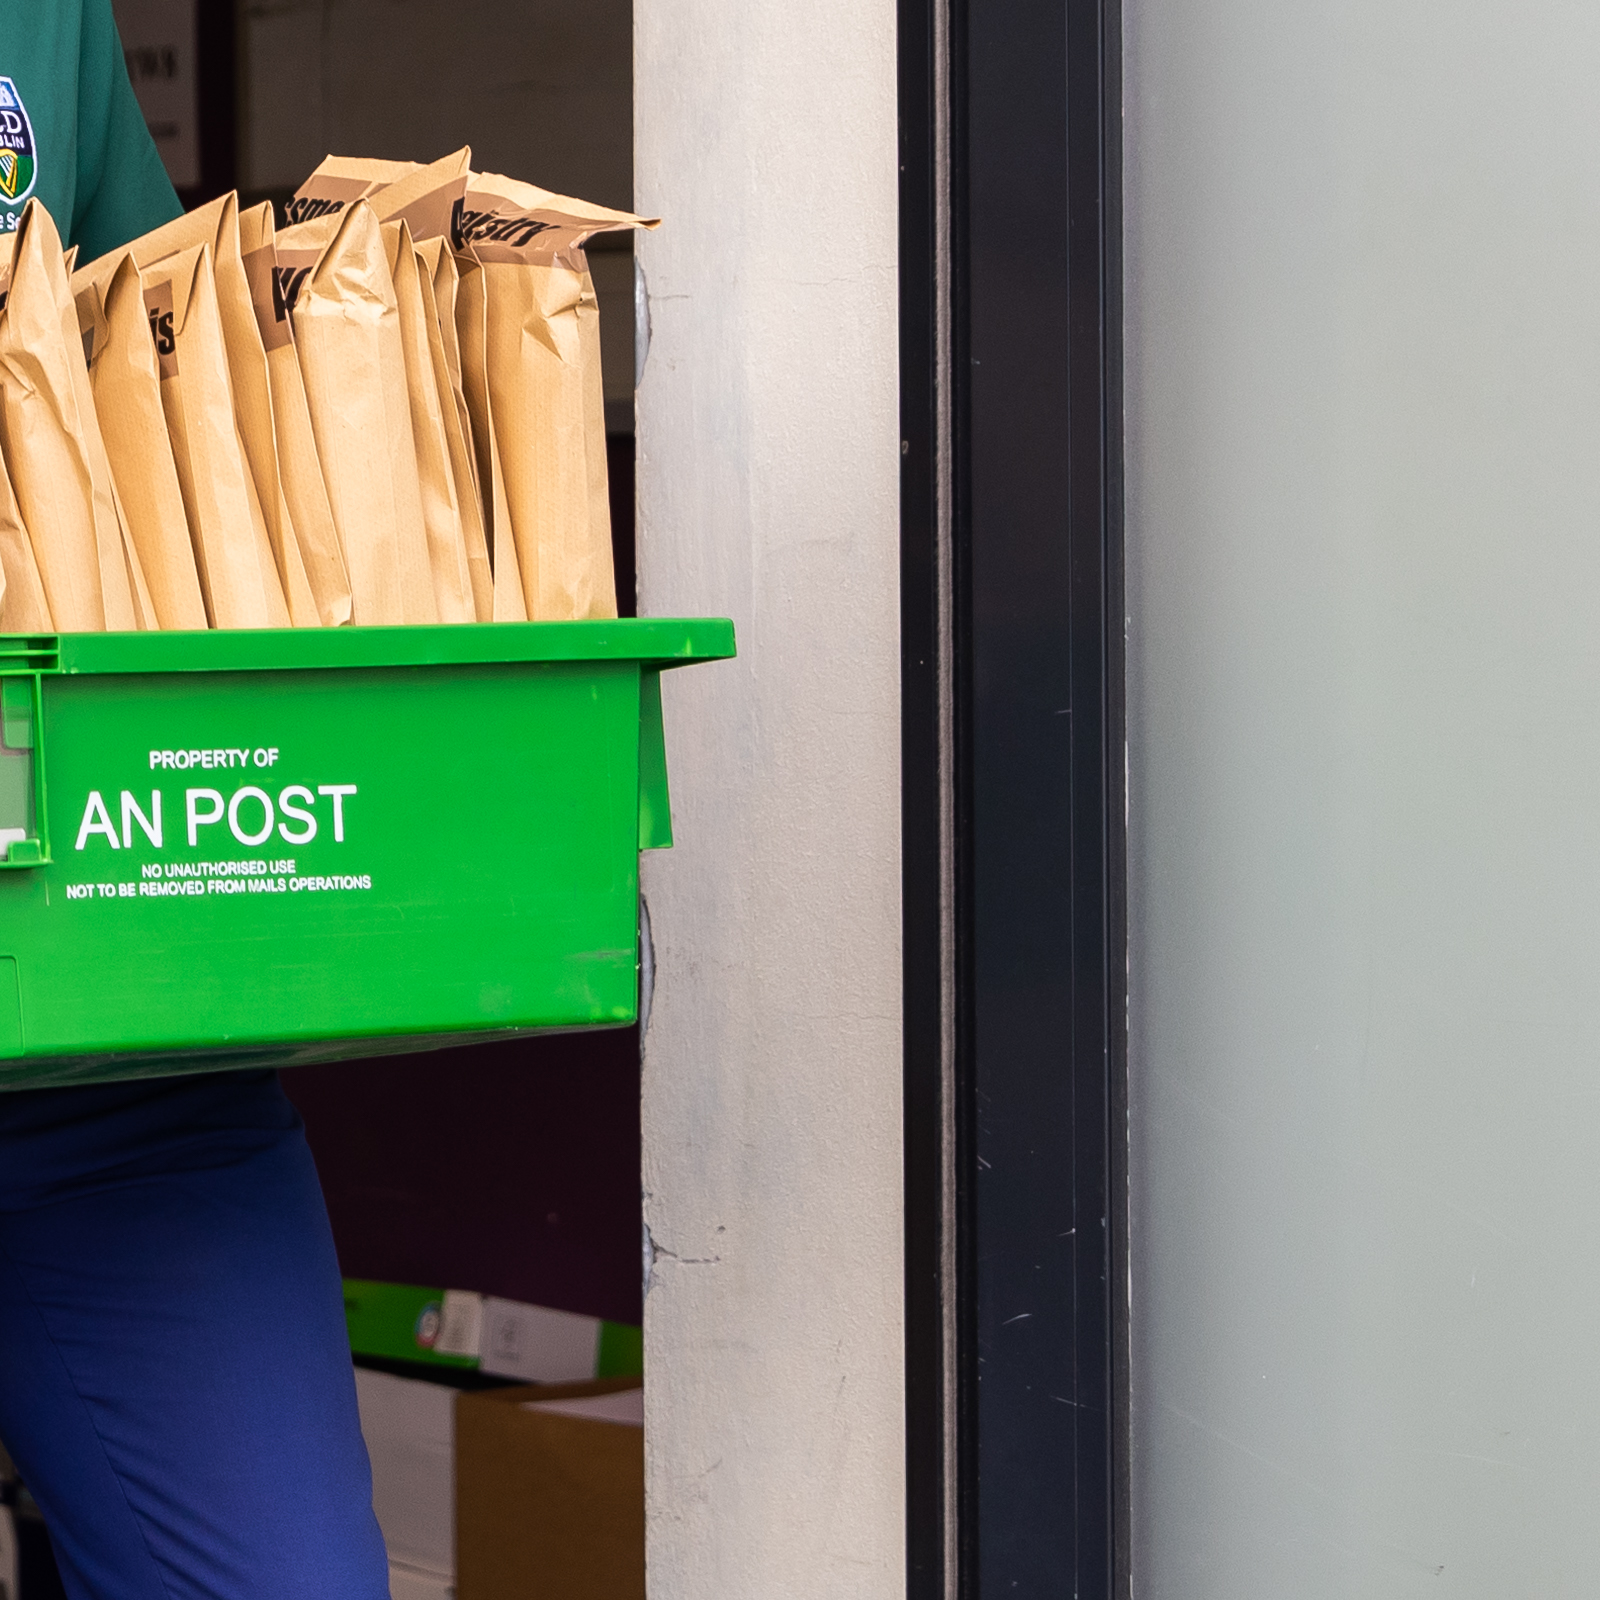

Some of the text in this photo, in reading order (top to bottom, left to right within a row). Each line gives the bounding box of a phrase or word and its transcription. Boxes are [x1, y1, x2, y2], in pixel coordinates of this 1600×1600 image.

[149, 747, 280, 770] PROPERTY OF
[74, 784, 358, 851] AN POST
[141, 859, 297, 879] NO UNAUTHORISED USE
[66, 875, 372, 900] NOT TO BE REMOVED FROM MAILS OPERATIONS
